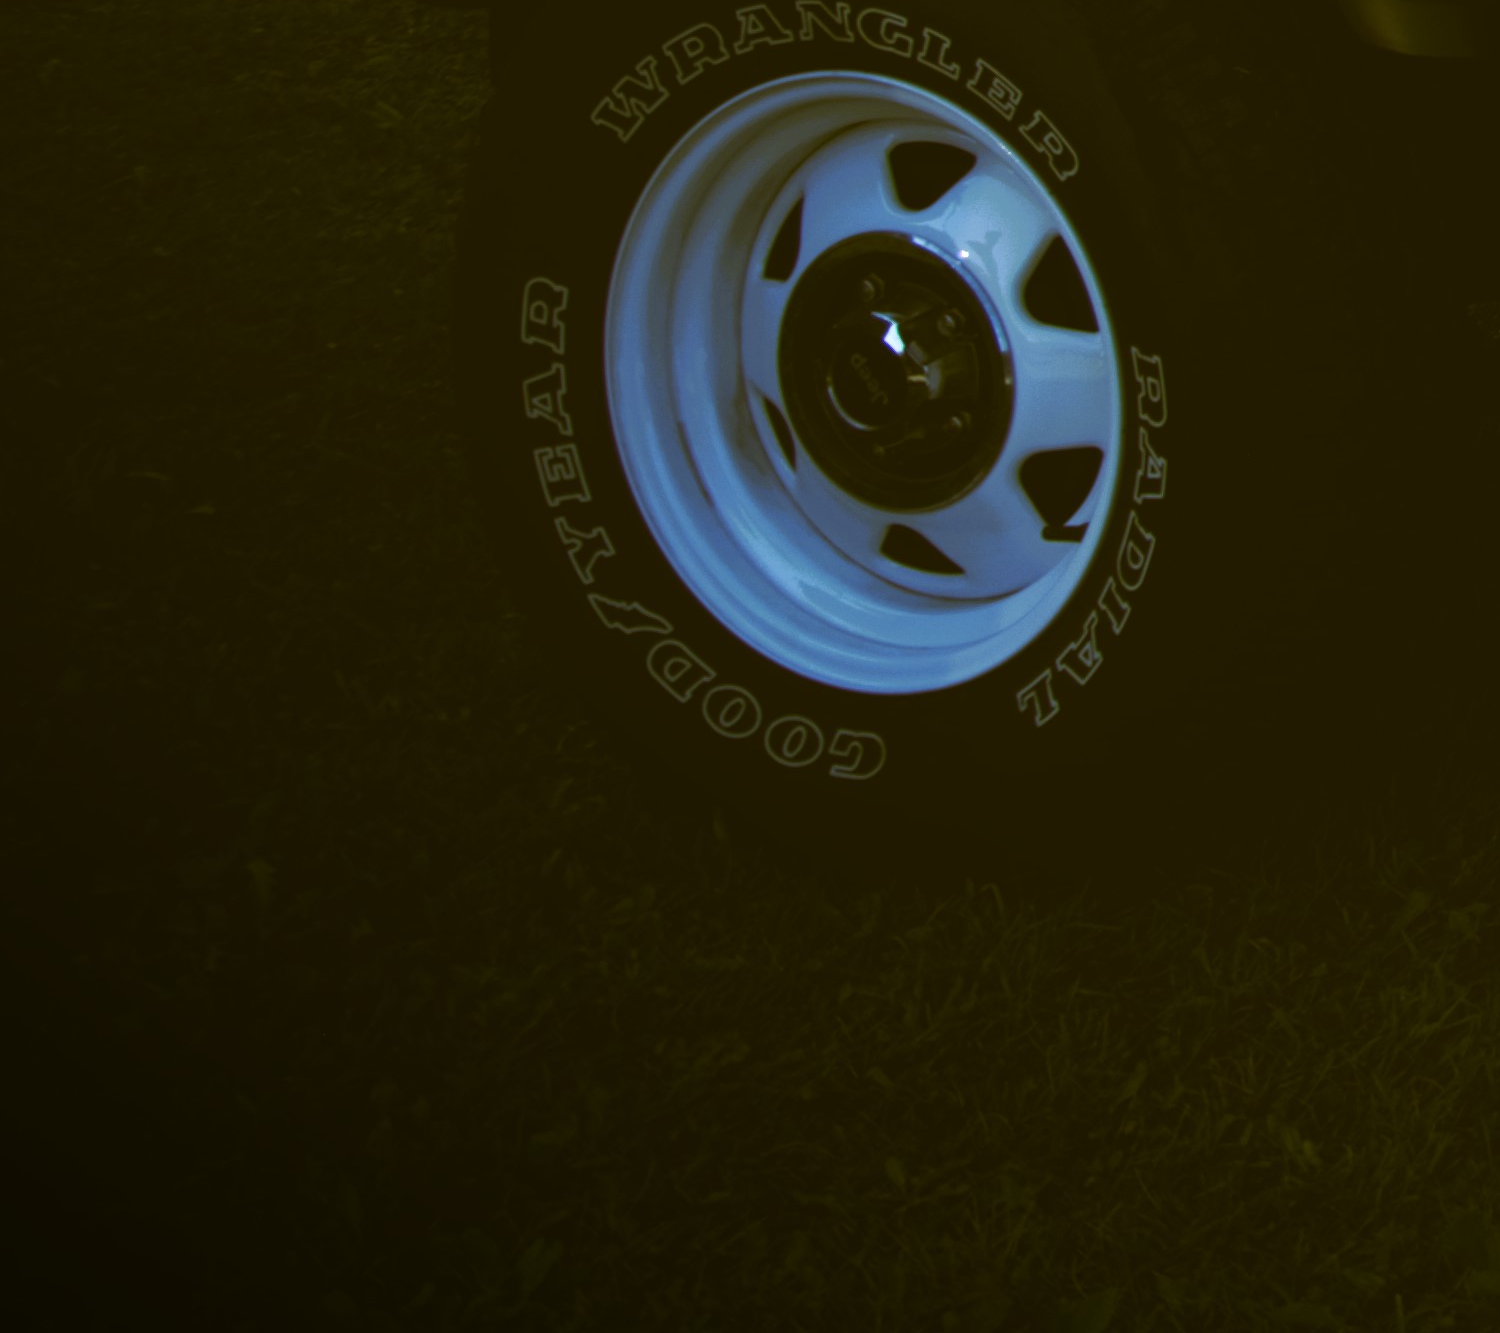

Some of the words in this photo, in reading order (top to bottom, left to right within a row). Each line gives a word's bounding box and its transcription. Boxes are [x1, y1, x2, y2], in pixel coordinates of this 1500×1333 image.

[590, 0, 1081, 183] WRANGLER
[849, 351, 889, 406] Jeep
[1017, 345, 1168, 727] RADIAL
